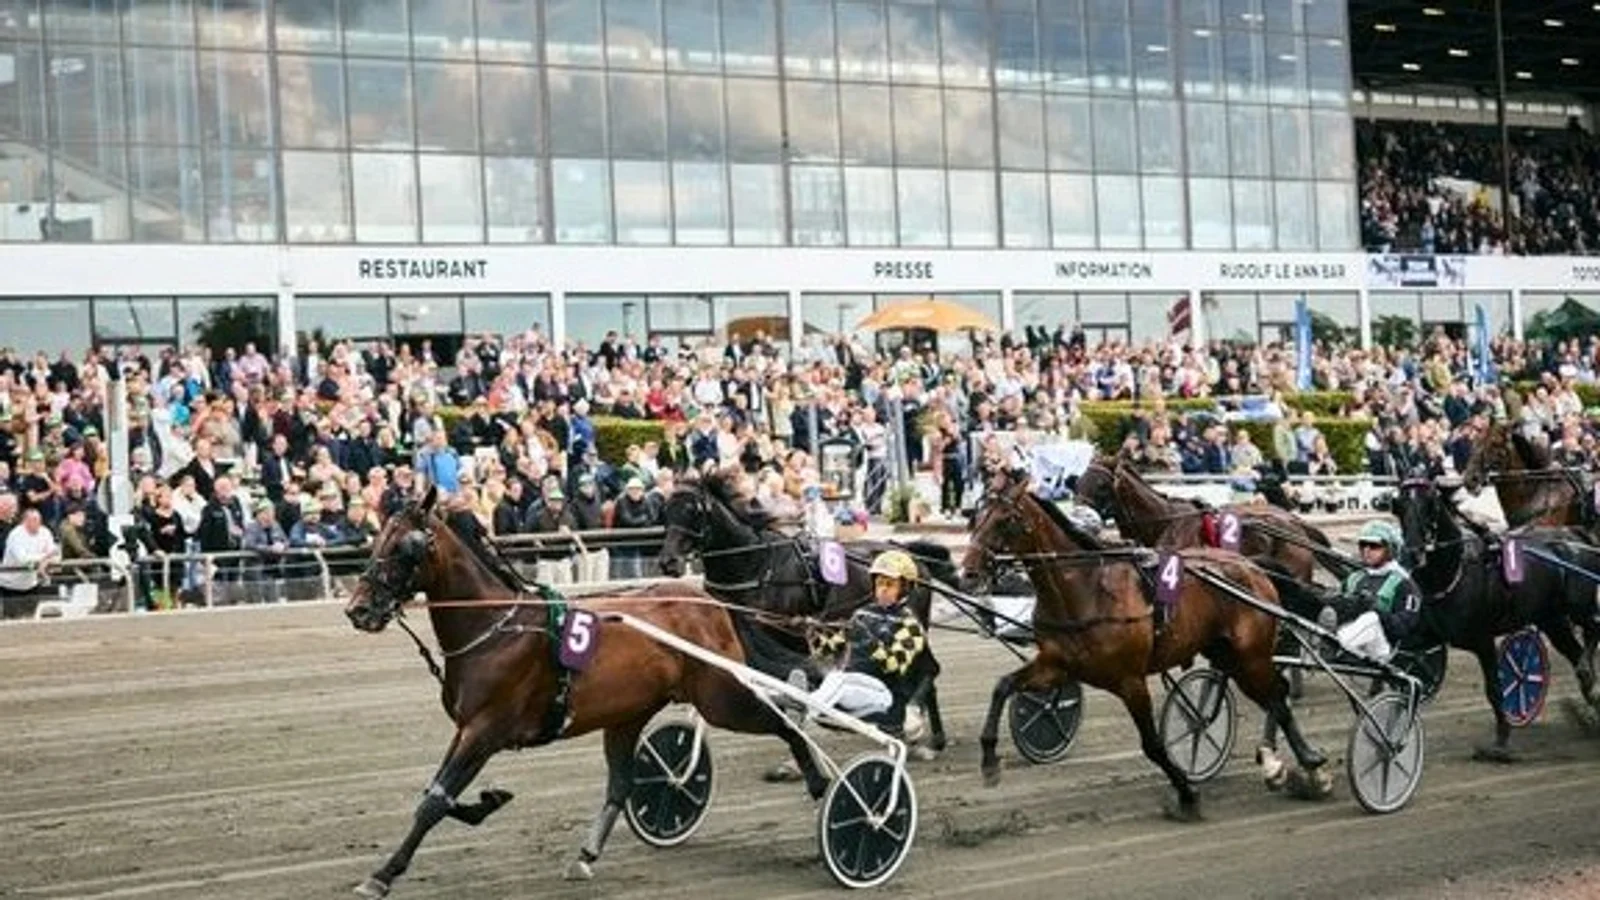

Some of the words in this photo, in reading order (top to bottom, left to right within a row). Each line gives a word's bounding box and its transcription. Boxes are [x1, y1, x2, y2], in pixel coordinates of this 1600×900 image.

[358, 258, 488, 278] RESTAURANT
[873, 261, 934, 279] PRESSE
[1055, 262, 1153, 278] INFORMATION
[1222, 513, 1239, 543] 2
[824, 542, 842, 574] 6
[1508, 540, 1516, 570] 1
[1161, 555, 1179, 590] 4
[567, 611, 593, 653] 5
